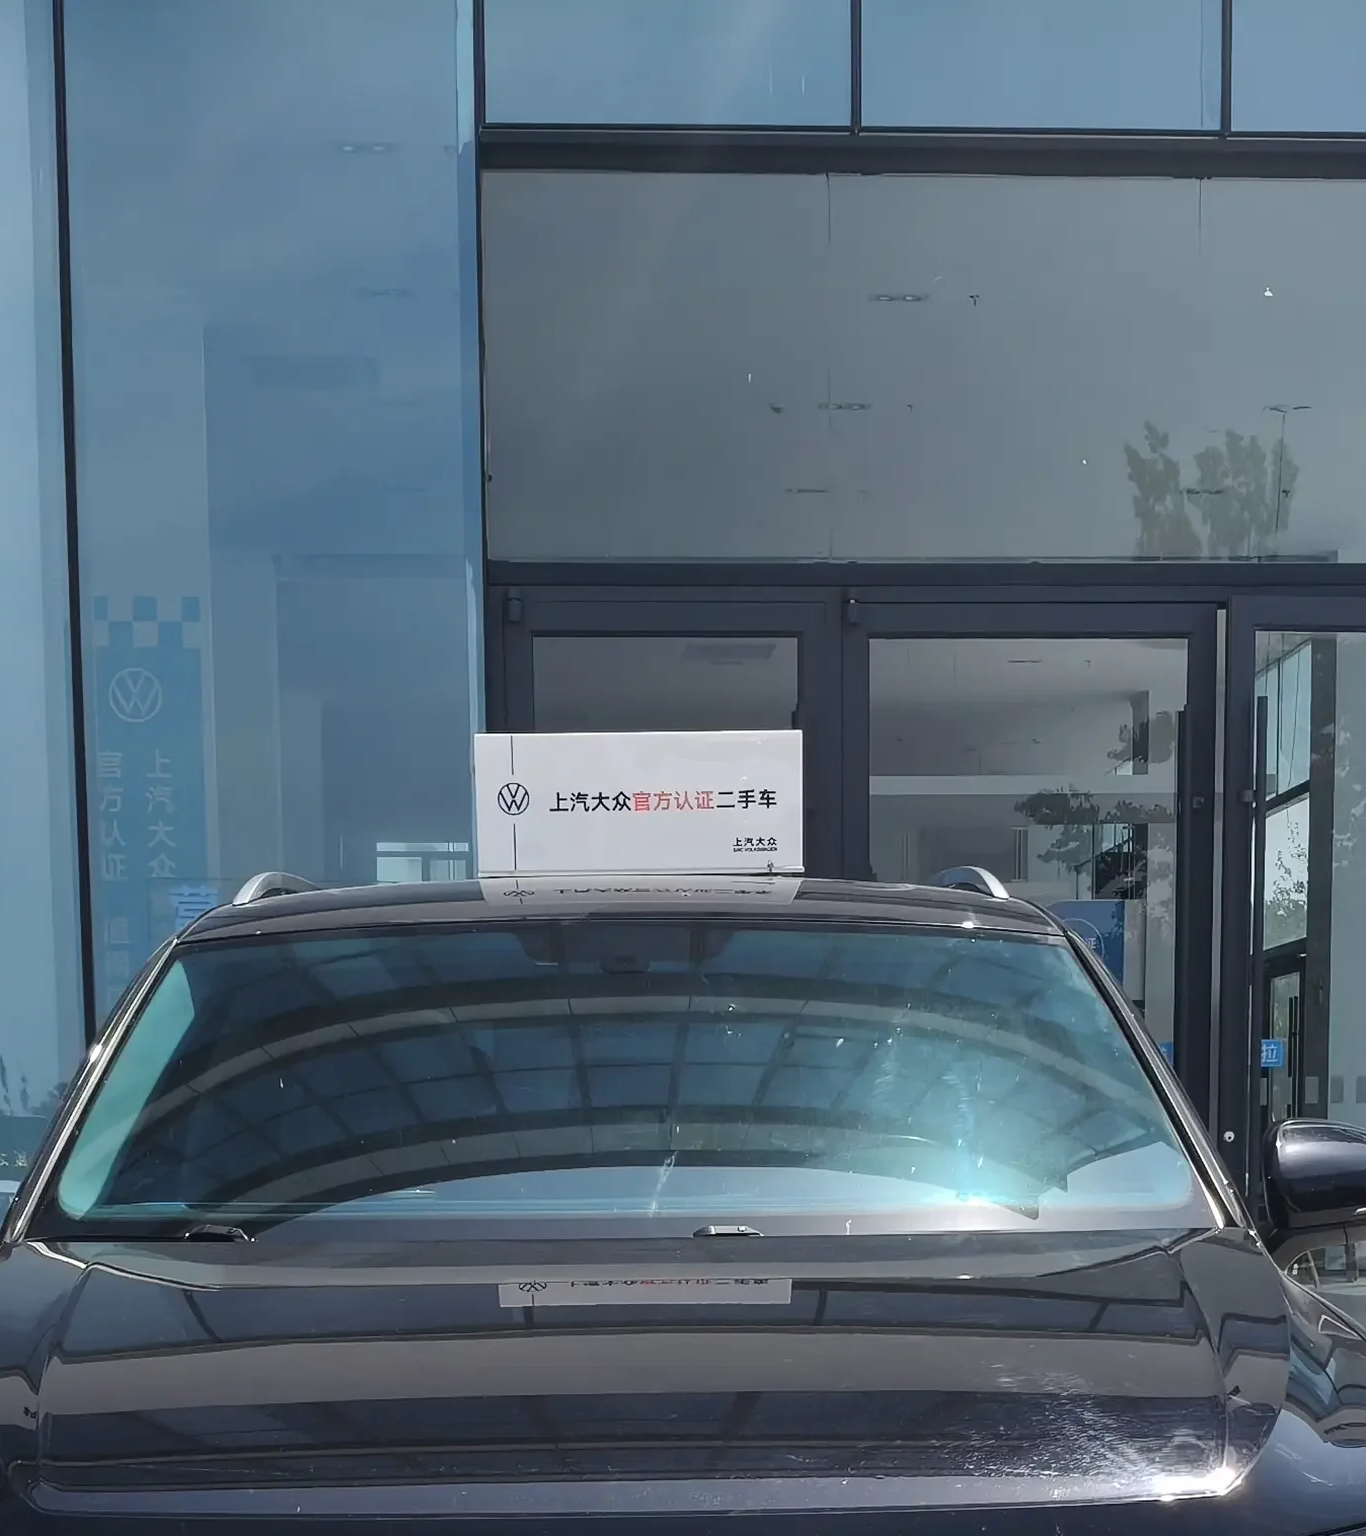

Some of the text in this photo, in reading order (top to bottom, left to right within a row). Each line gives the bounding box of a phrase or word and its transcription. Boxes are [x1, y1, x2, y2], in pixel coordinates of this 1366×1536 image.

[549, 789, 777, 813] 上汽大众官方认证二手车
